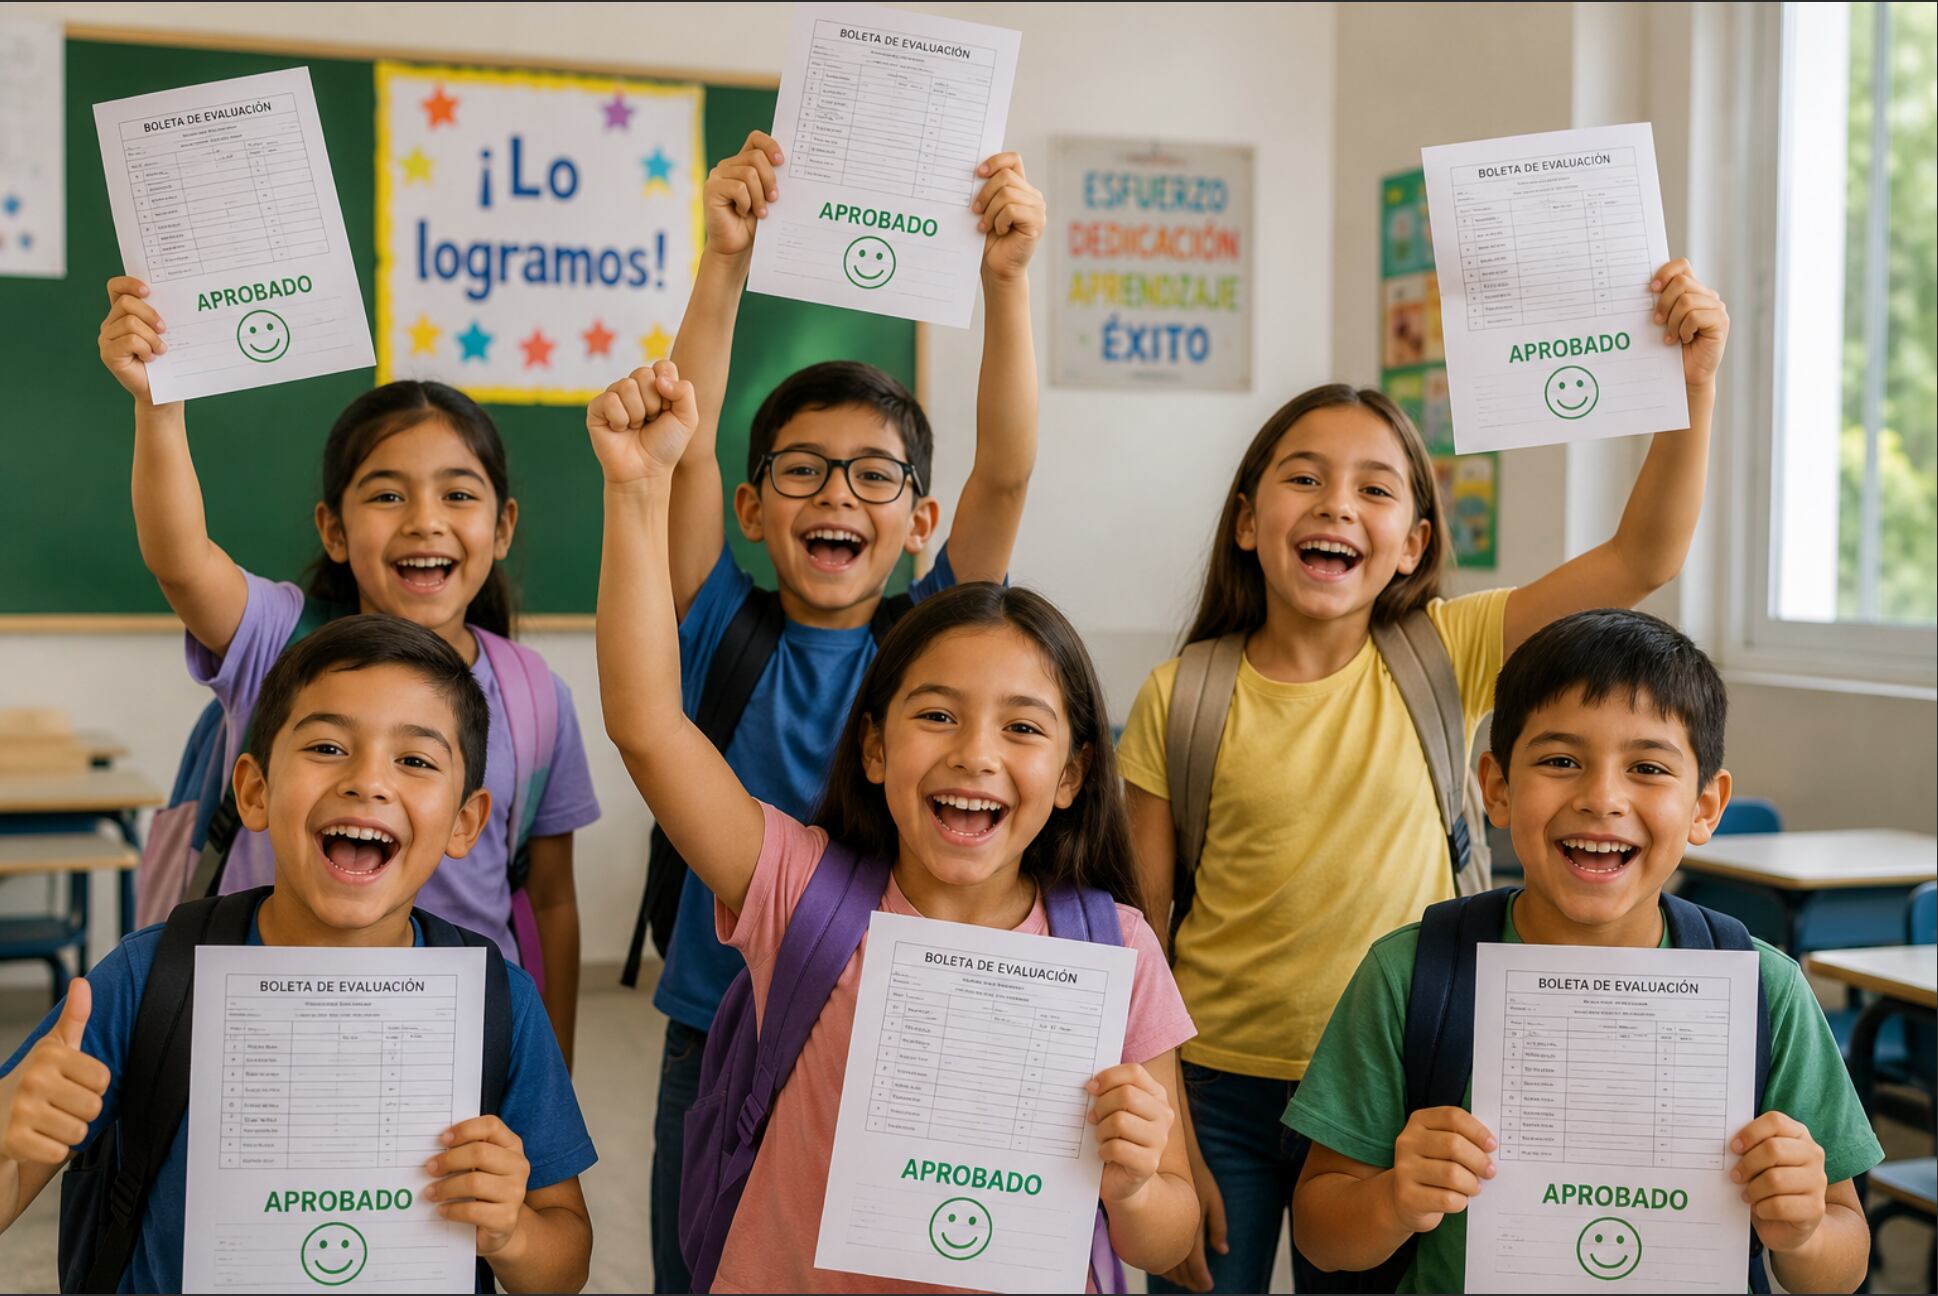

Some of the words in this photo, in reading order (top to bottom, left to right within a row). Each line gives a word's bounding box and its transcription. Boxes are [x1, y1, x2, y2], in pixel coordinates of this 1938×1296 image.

[839, 28, 882, 45] BOLETA
[884, 35, 900, 47] DE
[902, 38, 971, 59] EVALUACIÓN
[143, 115, 184, 133] BOLETA
[187, 113, 201, 124] DE
[204, 101, 272, 122] EVALUACIÓN
[479, 134, 580, 209] ¡Lo
[1478, 164, 1522, 179] BOLETA
[1525, 161, 1540, 173] DE
[1542, 152, 1611, 171] EVALUACIÓN
[1084, 170, 1229, 213] ESFUERZO
[819, 201, 938, 237] APROBADO
[1068, 218, 1240, 263] DEDICACIÓN
[416, 218, 666, 302] logramos!
[197, 275, 313, 312] APROBADO
[1102, 312, 1210, 364] ÉXITO
[1508, 332, 1631, 363] APROBADO
[924, 951, 974, 970] BOLETA
[977, 959, 995, 972] DE
[998, 962, 1078, 984] EVALUACIÓN
[260, 980, 313, 992] BOLETA
[317, 980, 334, 992] DE
[340, 977, 425, 992] EVALUACIÓN
[1539, 977, 1590, 991] BOLETA
[1593, 979, 1611, 992] DE
[1615, 979, 1699, 994] EVALUACIÓN
[901, 1159, 1043, 1196] APROBADO
[264, 1188, 413, 1213] APROBADO
[1542, 1183, 1689, 1211] APROBADO
